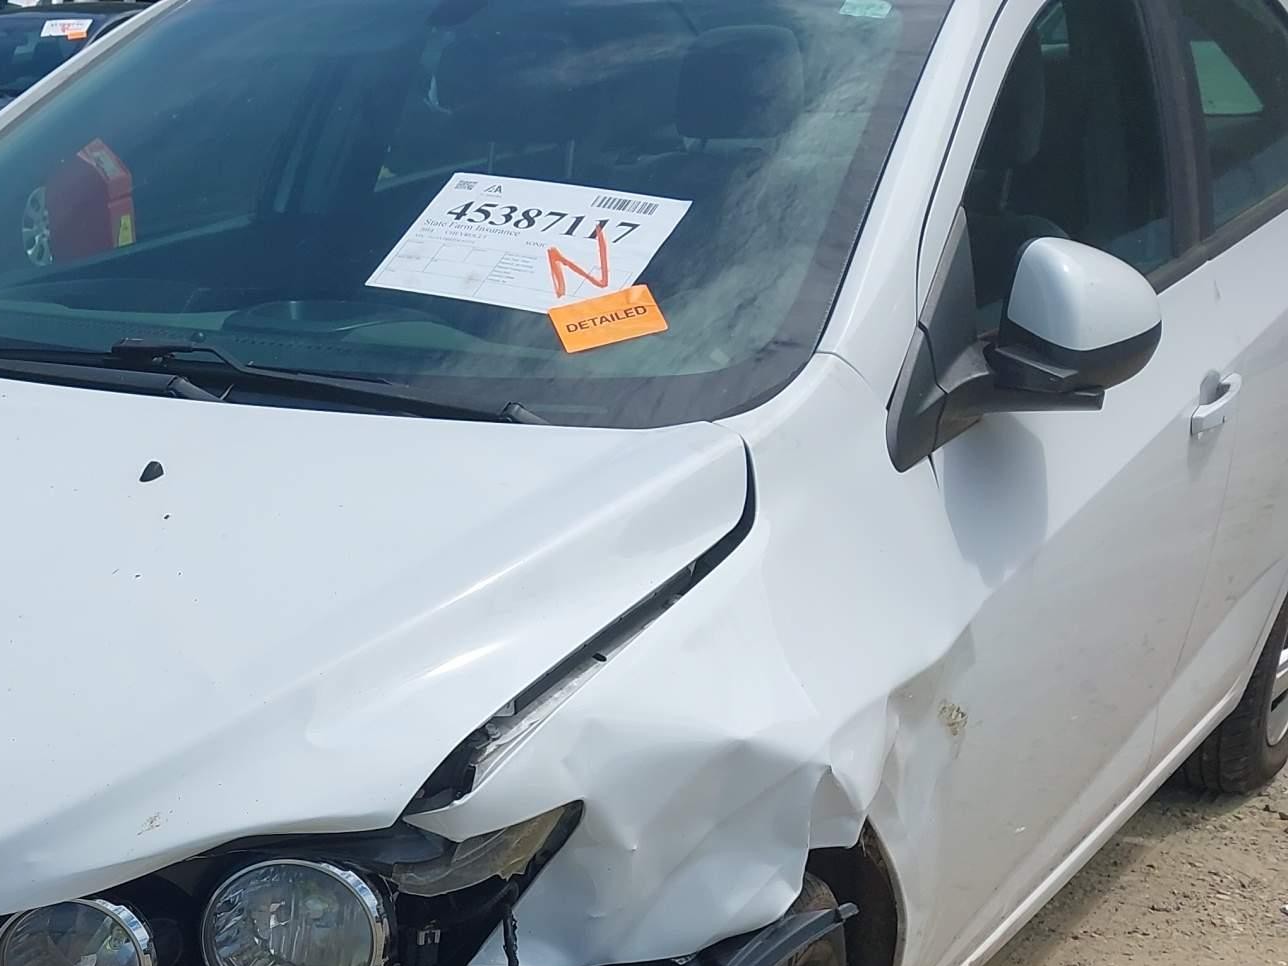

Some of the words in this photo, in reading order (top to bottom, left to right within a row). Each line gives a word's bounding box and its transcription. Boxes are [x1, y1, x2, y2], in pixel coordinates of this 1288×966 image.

[424, 218, 448, 228] State
[448, 221, 473, 231] Farm
[475, 224, 521, 237] Insurance
[447, 200, 641, 244] 45387117
[547, 224, 609, 299] N
[565, 304, 648, 333] DETAILED
